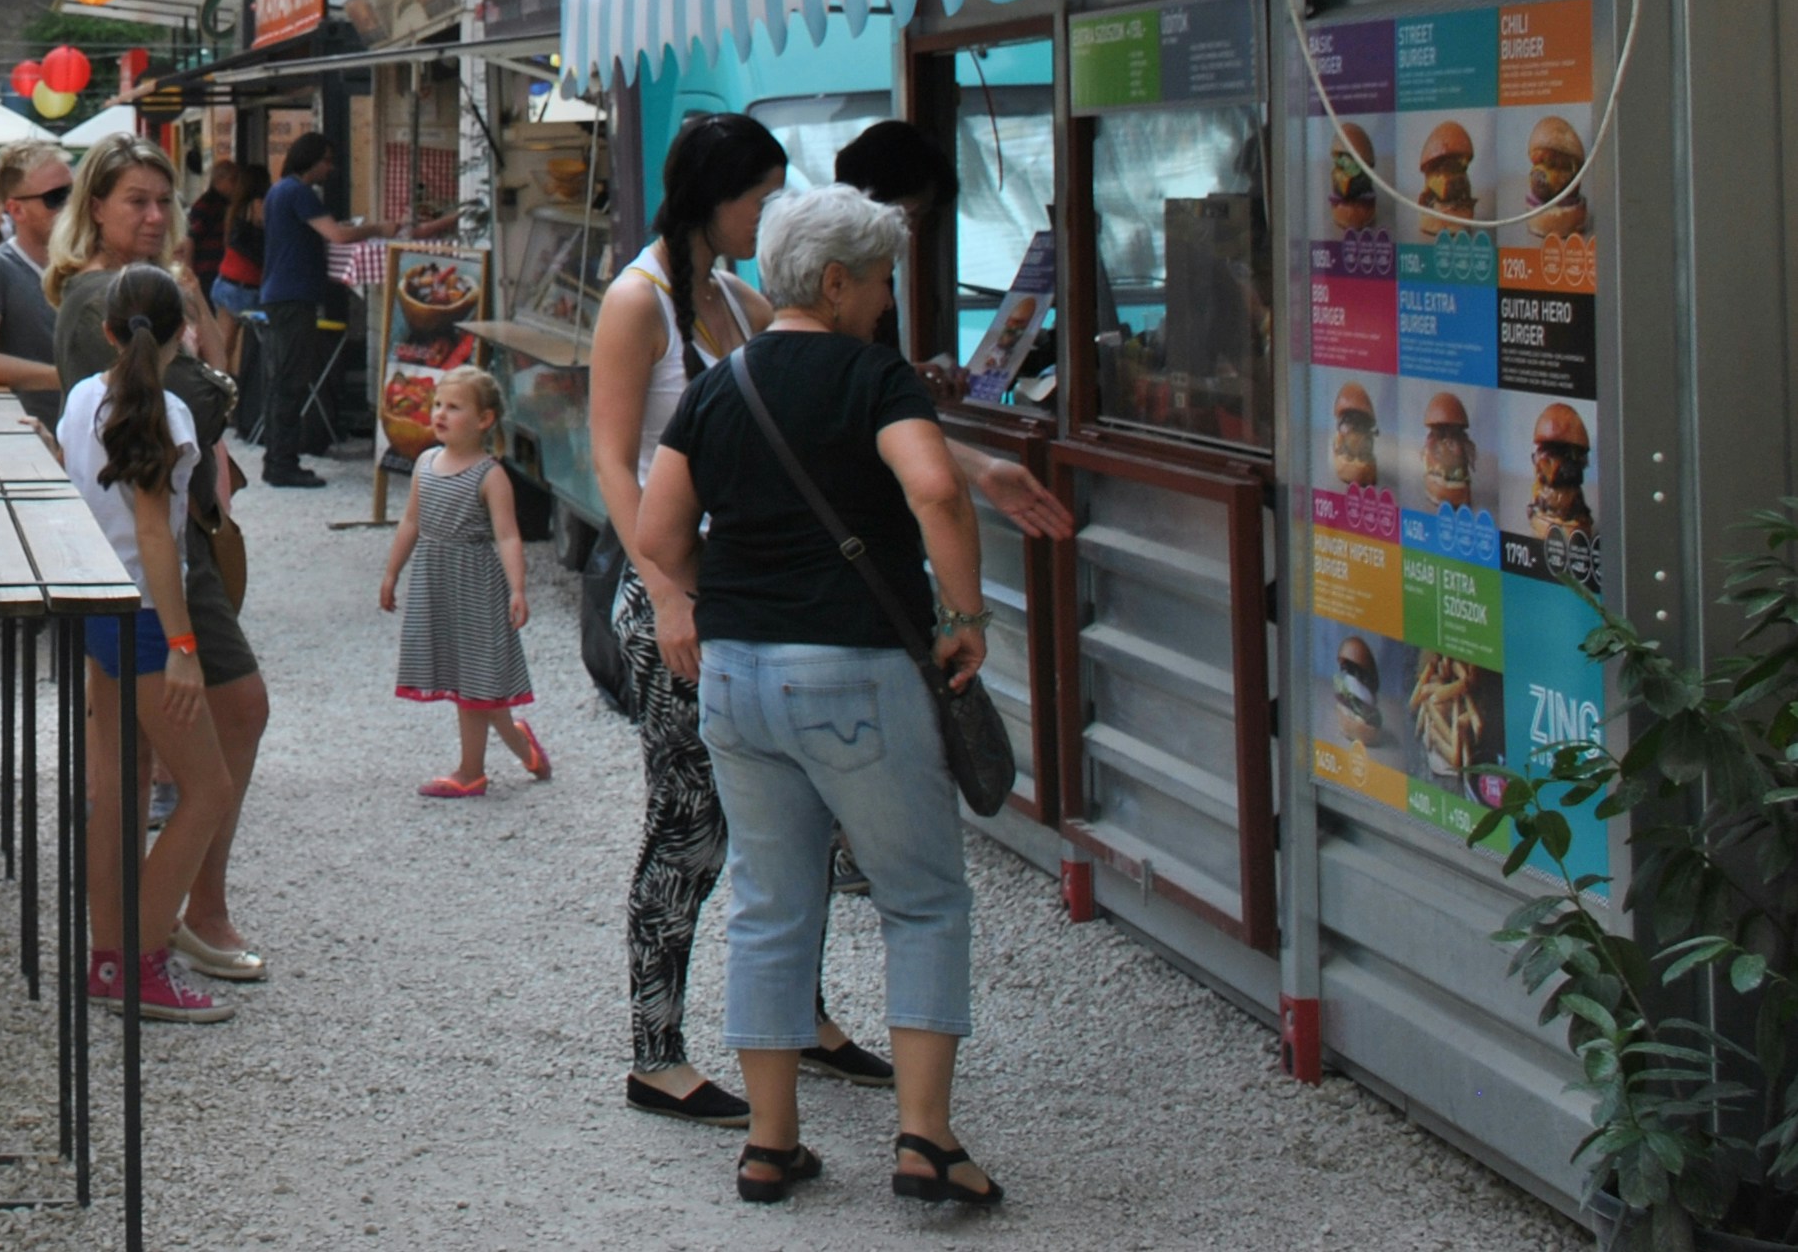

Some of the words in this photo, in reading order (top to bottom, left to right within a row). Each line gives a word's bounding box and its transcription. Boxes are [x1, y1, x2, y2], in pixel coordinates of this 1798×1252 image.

[1399, 23, 1434, 45] STREET
[1501, 14, 1528, 35] CHILI
[1399, 47, 1437, 68] BURGER
[1501, 37, 1544, 59] BURGER
[1311, 55, 1343, 76] URGER
[1400, 290, 1423, 311] FULL
[1424, 293, 1456, 314] EXTRA
[1501, 298, 1539, 321] GUITAR
[1542, 300, 1571, 324] HERO
[1312, 307, 1345, 326] BURGER
[1400, 313, 1437, 335] BURGER
[1502, 322, 1545, 346] BURGER
[1314, 555, 1349, 580] BURGER
[1444, 569, 1476, 596] EXTRA
